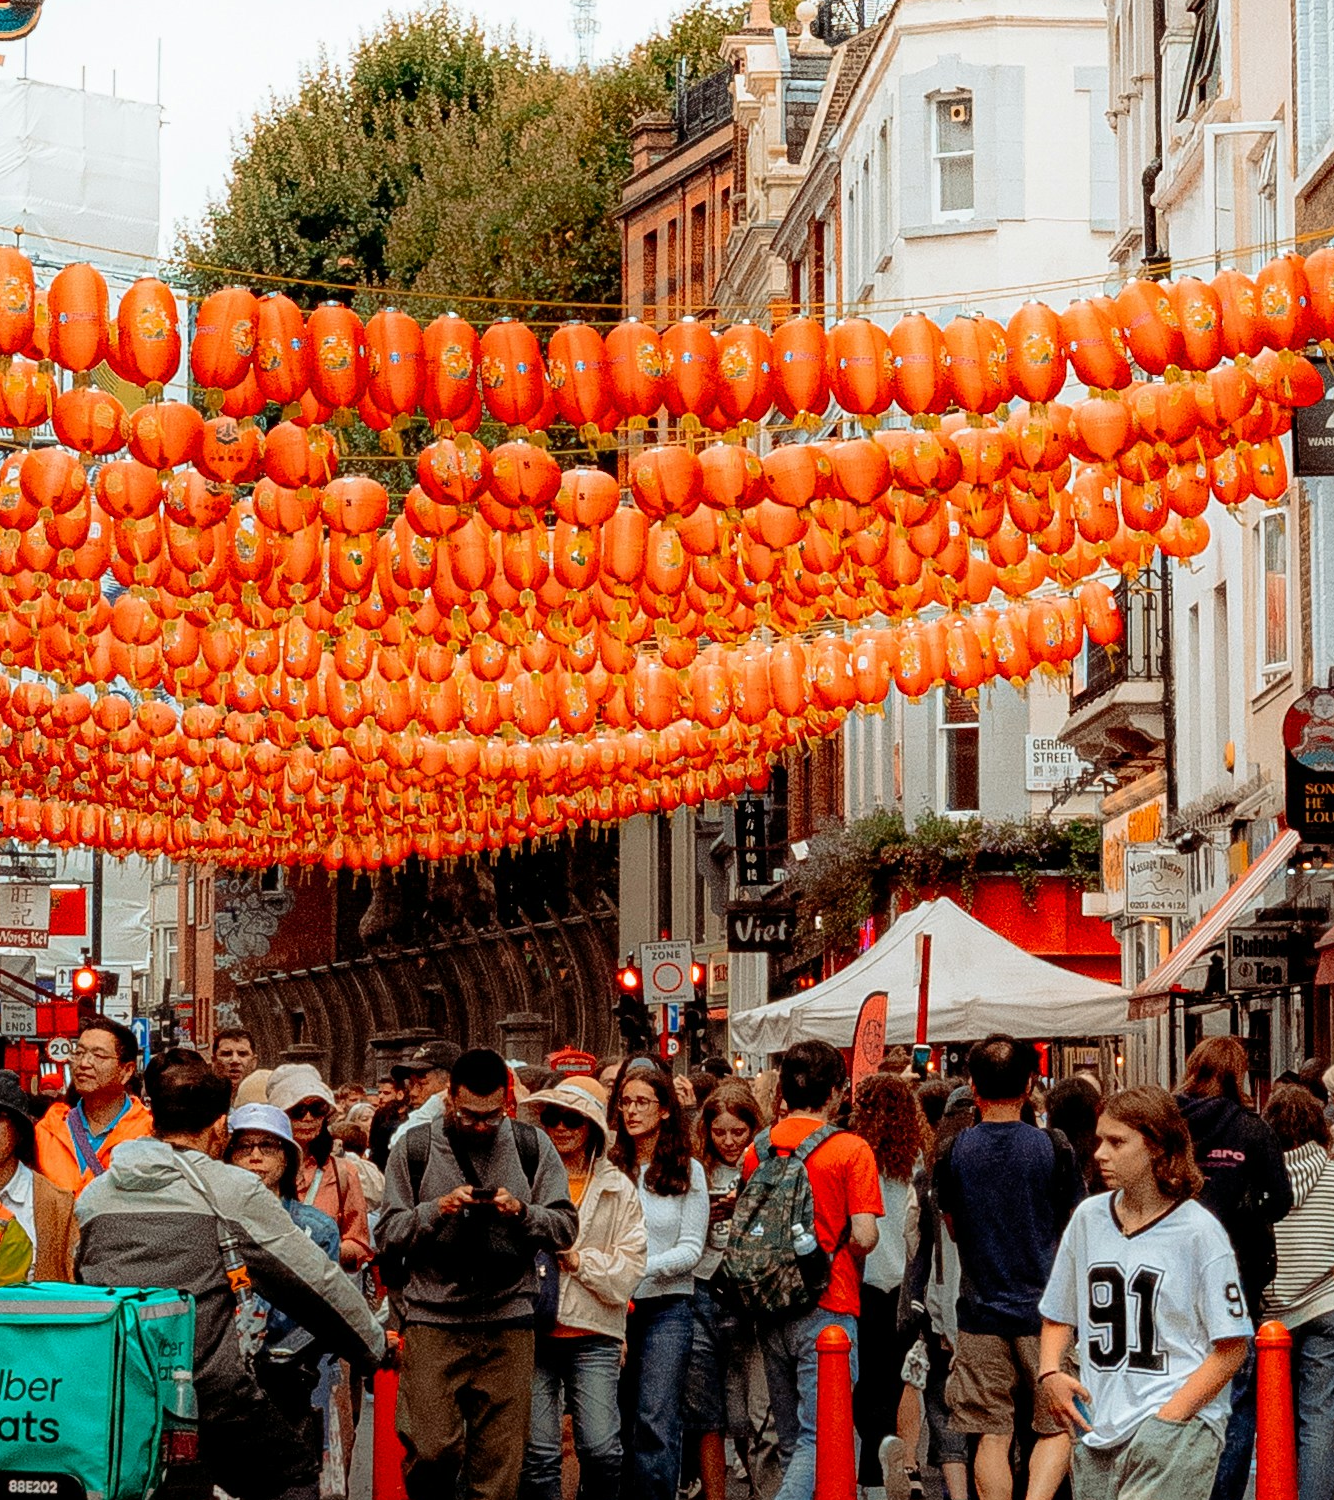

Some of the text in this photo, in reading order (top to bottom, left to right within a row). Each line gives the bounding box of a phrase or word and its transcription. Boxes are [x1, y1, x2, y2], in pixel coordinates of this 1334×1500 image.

[1033, 753, 1072, 763] STREET
[1306, 797, 1325, 809] HE
[1130, 855, 1186, 878] Massage Therapy
[1130, 902, 1149, 910] 0203
[735, 915, 788, 942] Viet
[31, 930, 47, 945] Kei
[652, 950, 681, 960] ZONE
[1253, 962, 1282, 984] Tea
[5, 1022, 33, 1033] ENDS
[50, 1042, 70, 1056] 20
[1087, 1262, 1169, 1375] 91
[8, 1480, 58, 1494] 88E202
